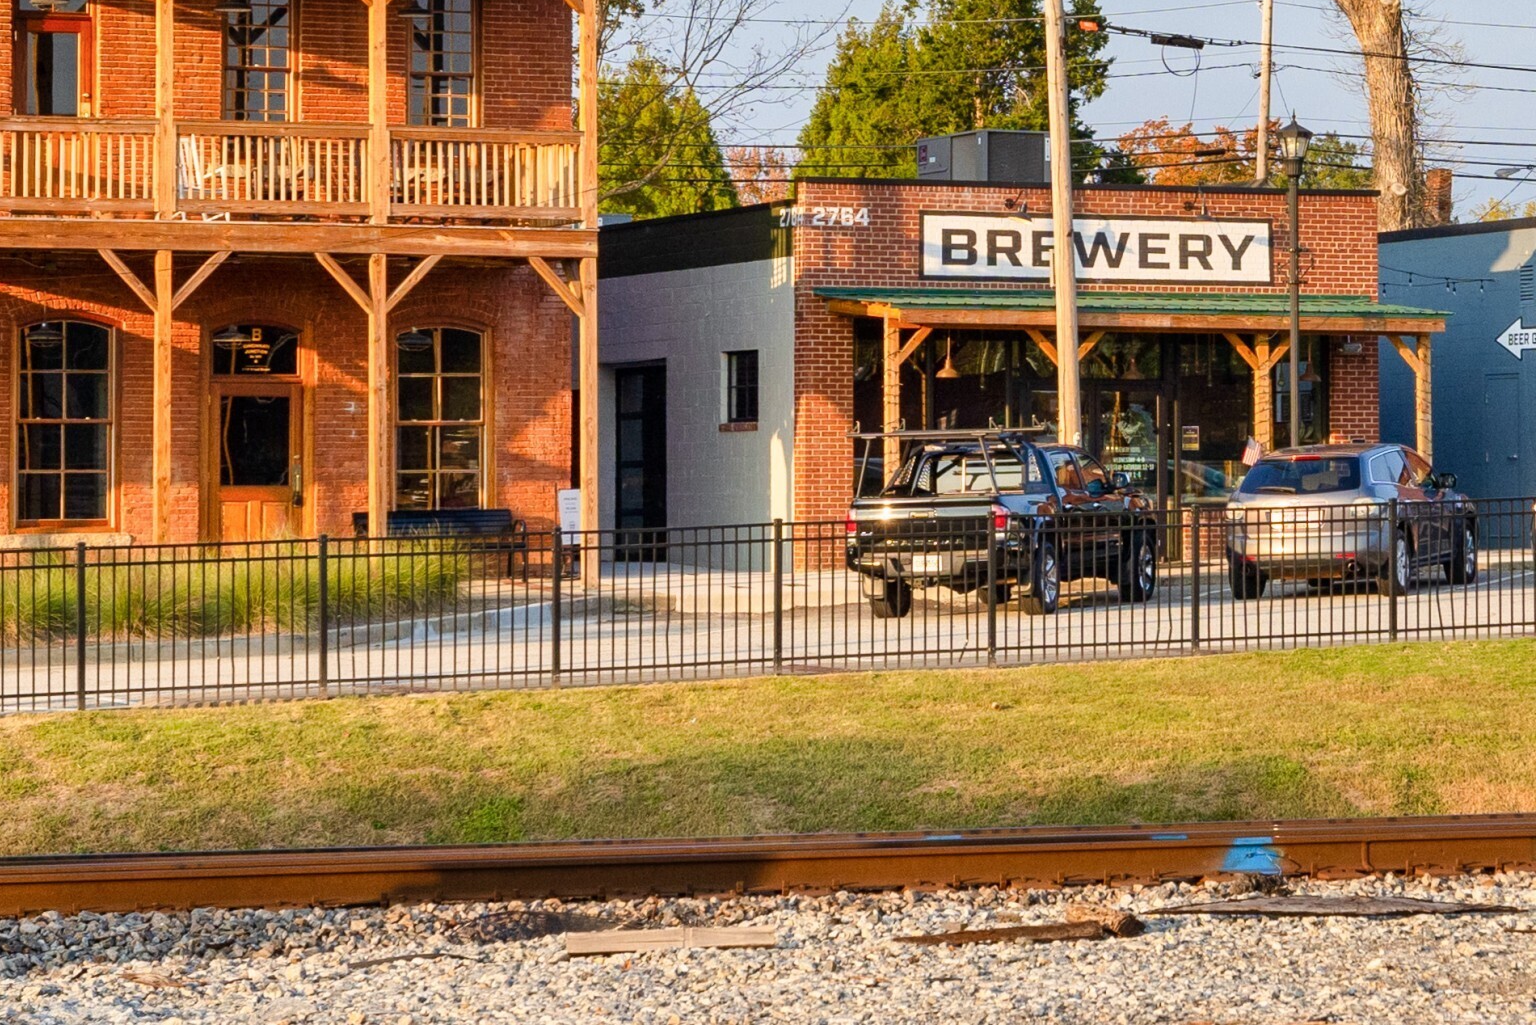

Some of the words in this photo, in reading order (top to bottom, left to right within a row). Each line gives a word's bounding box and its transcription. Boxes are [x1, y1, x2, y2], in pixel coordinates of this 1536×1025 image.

[813, 206, 870, 226] 2764
[941, 228, 1256, 271] BREWERY
[1508, 333, 1529, 345] BEER
